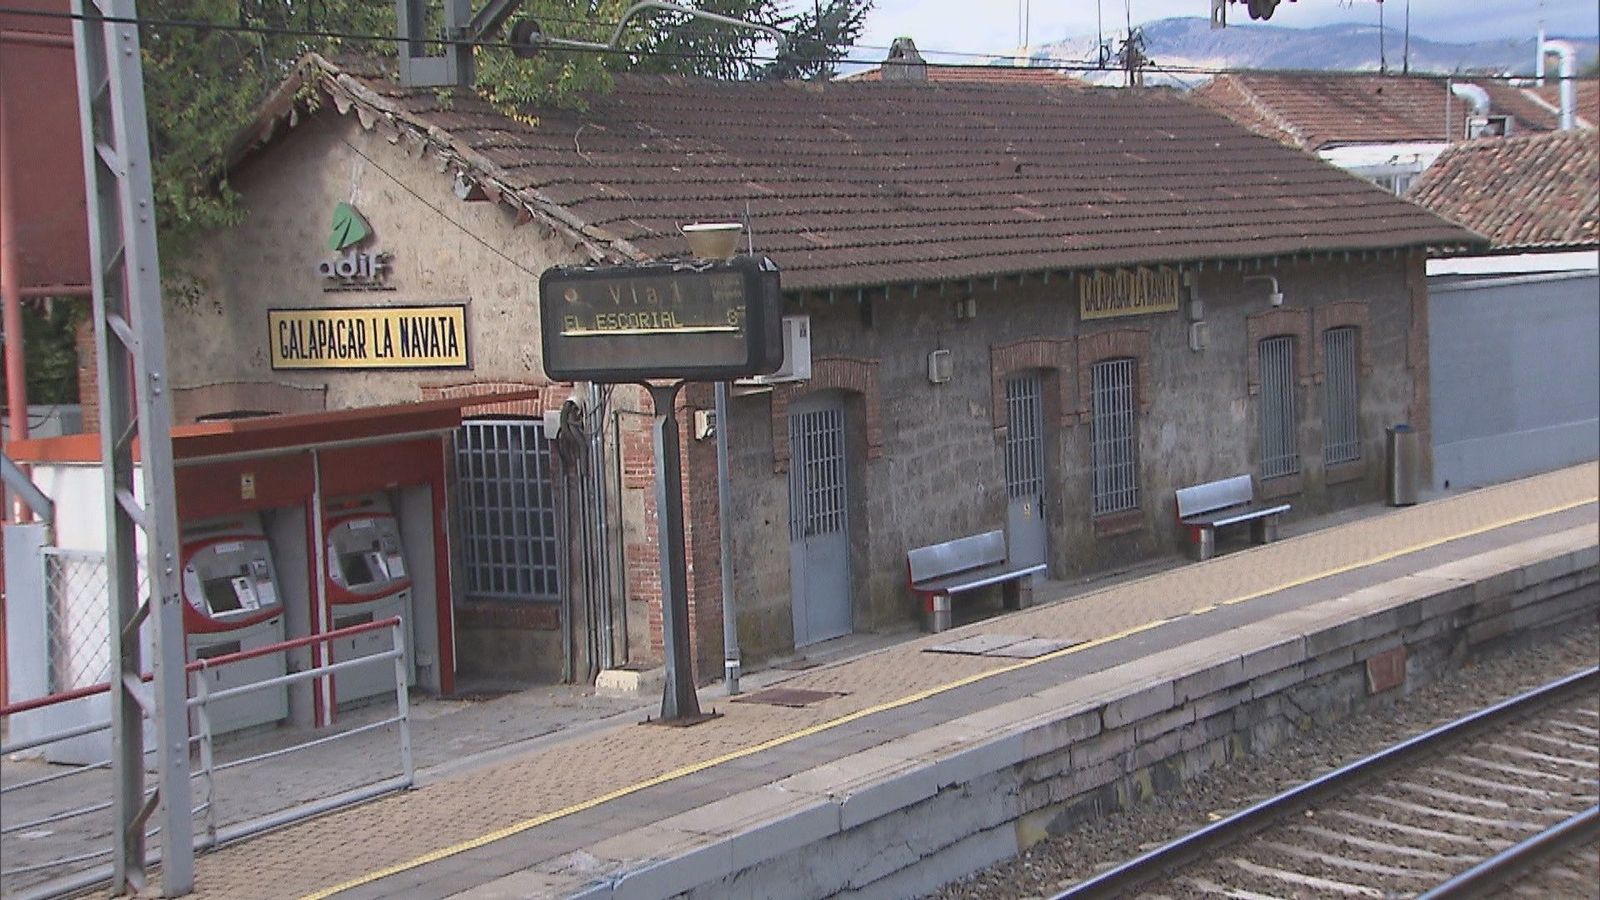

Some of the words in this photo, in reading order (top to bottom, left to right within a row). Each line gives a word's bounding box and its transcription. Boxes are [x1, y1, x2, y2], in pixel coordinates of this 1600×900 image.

[316, 250, 394, 279] adif
[564, 315, 587, 331] EL
[596, 311, 684, 329] ESCORIAL
[279, 318, 367, 359] GALAPAGAR
[372, 318, 395, 358] LA
[400, 316, 459, 357] NAVATA
